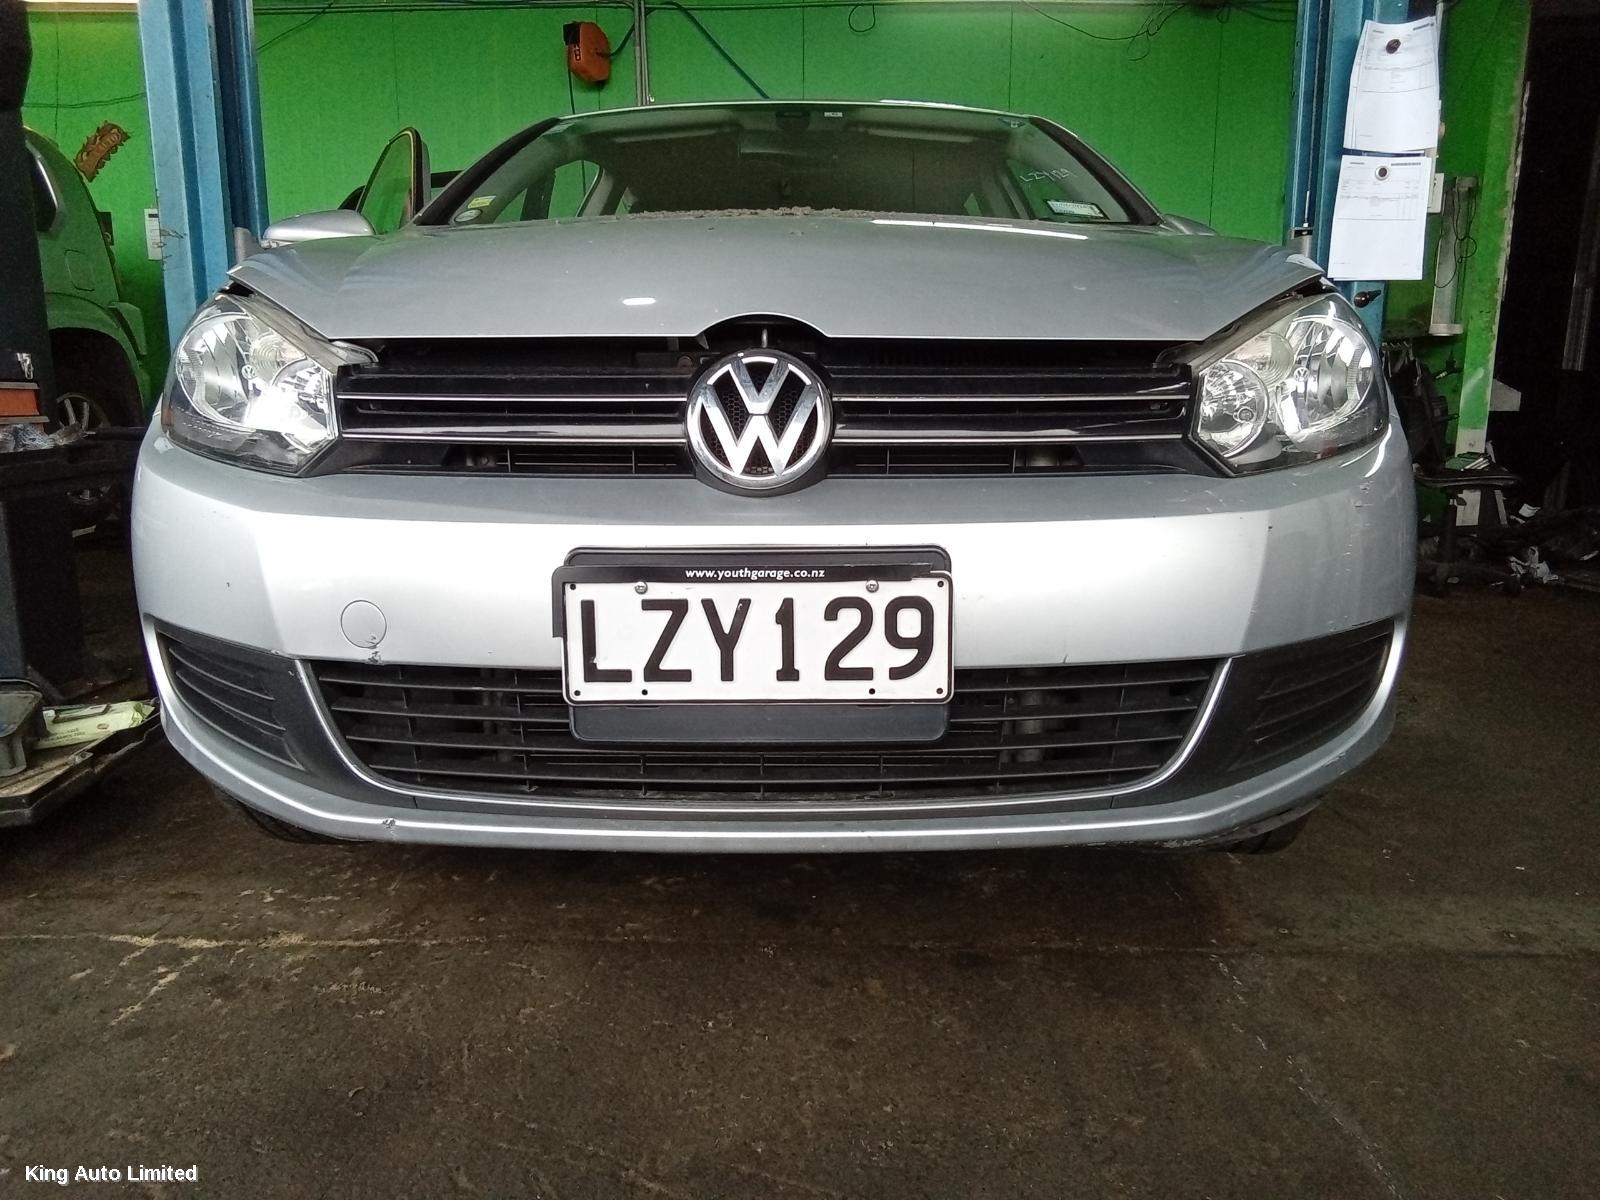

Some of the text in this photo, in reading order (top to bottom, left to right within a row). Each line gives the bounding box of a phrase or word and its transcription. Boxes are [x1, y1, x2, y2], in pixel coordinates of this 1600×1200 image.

[696, 354, 822, 478] VW
[685, 567, 825, 581] www.youthgarage.co.nz
[580, 596, 934, 683] LZY129
